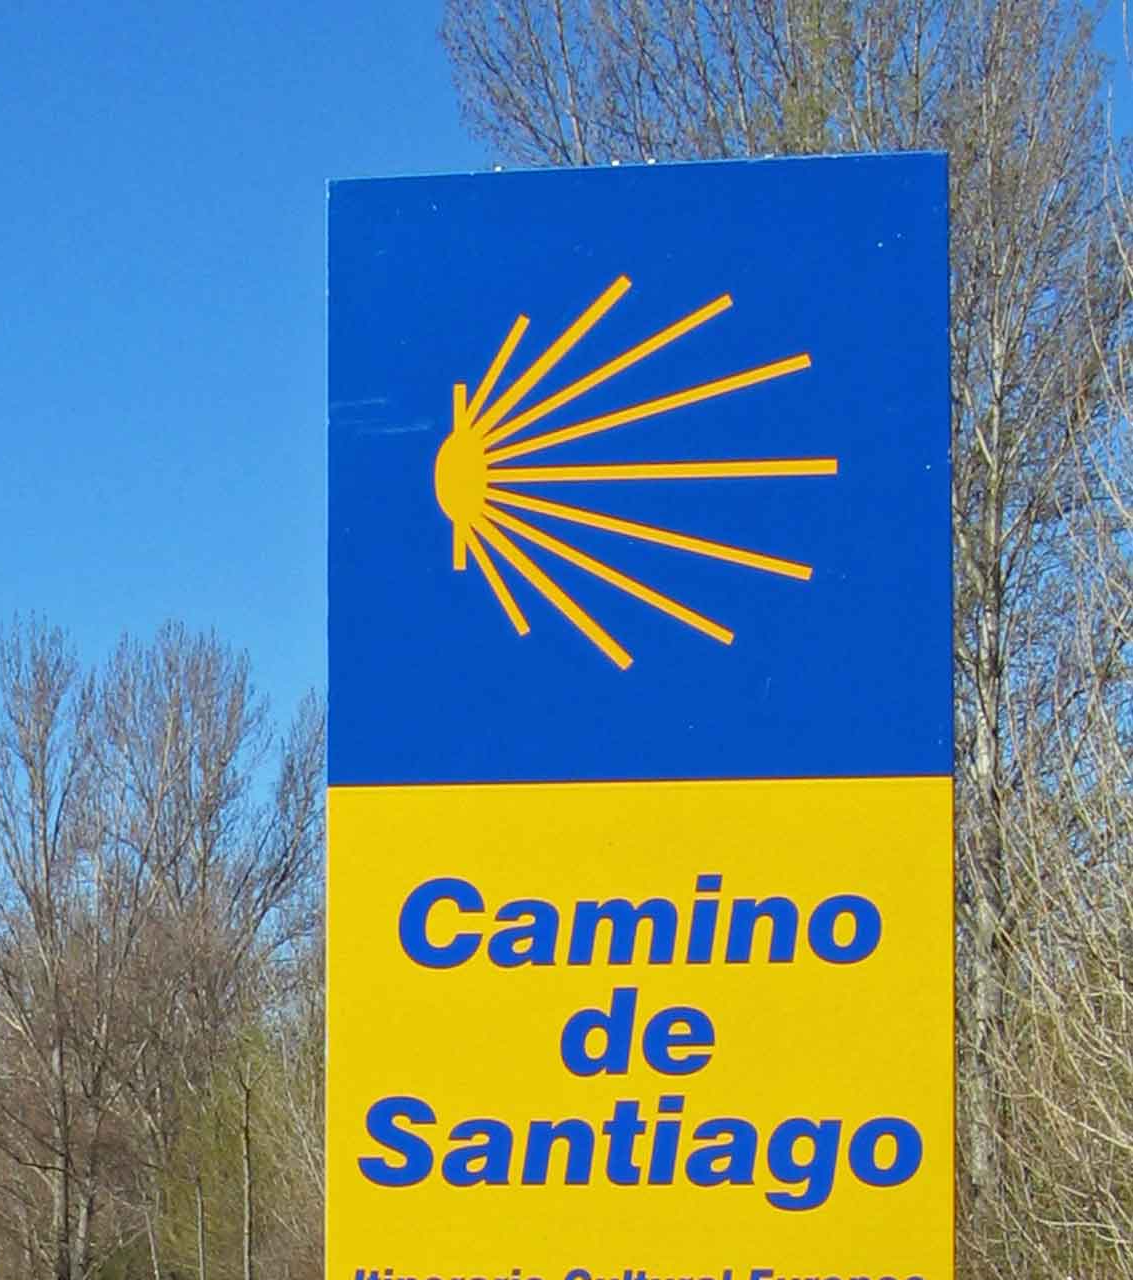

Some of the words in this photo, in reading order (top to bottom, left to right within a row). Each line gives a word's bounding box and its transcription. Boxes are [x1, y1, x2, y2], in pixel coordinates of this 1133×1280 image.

[398, 874, 883, 969] Camino
[560, 986, 716, 1078] de
[357, 1094, 924, 1212] Santiago
